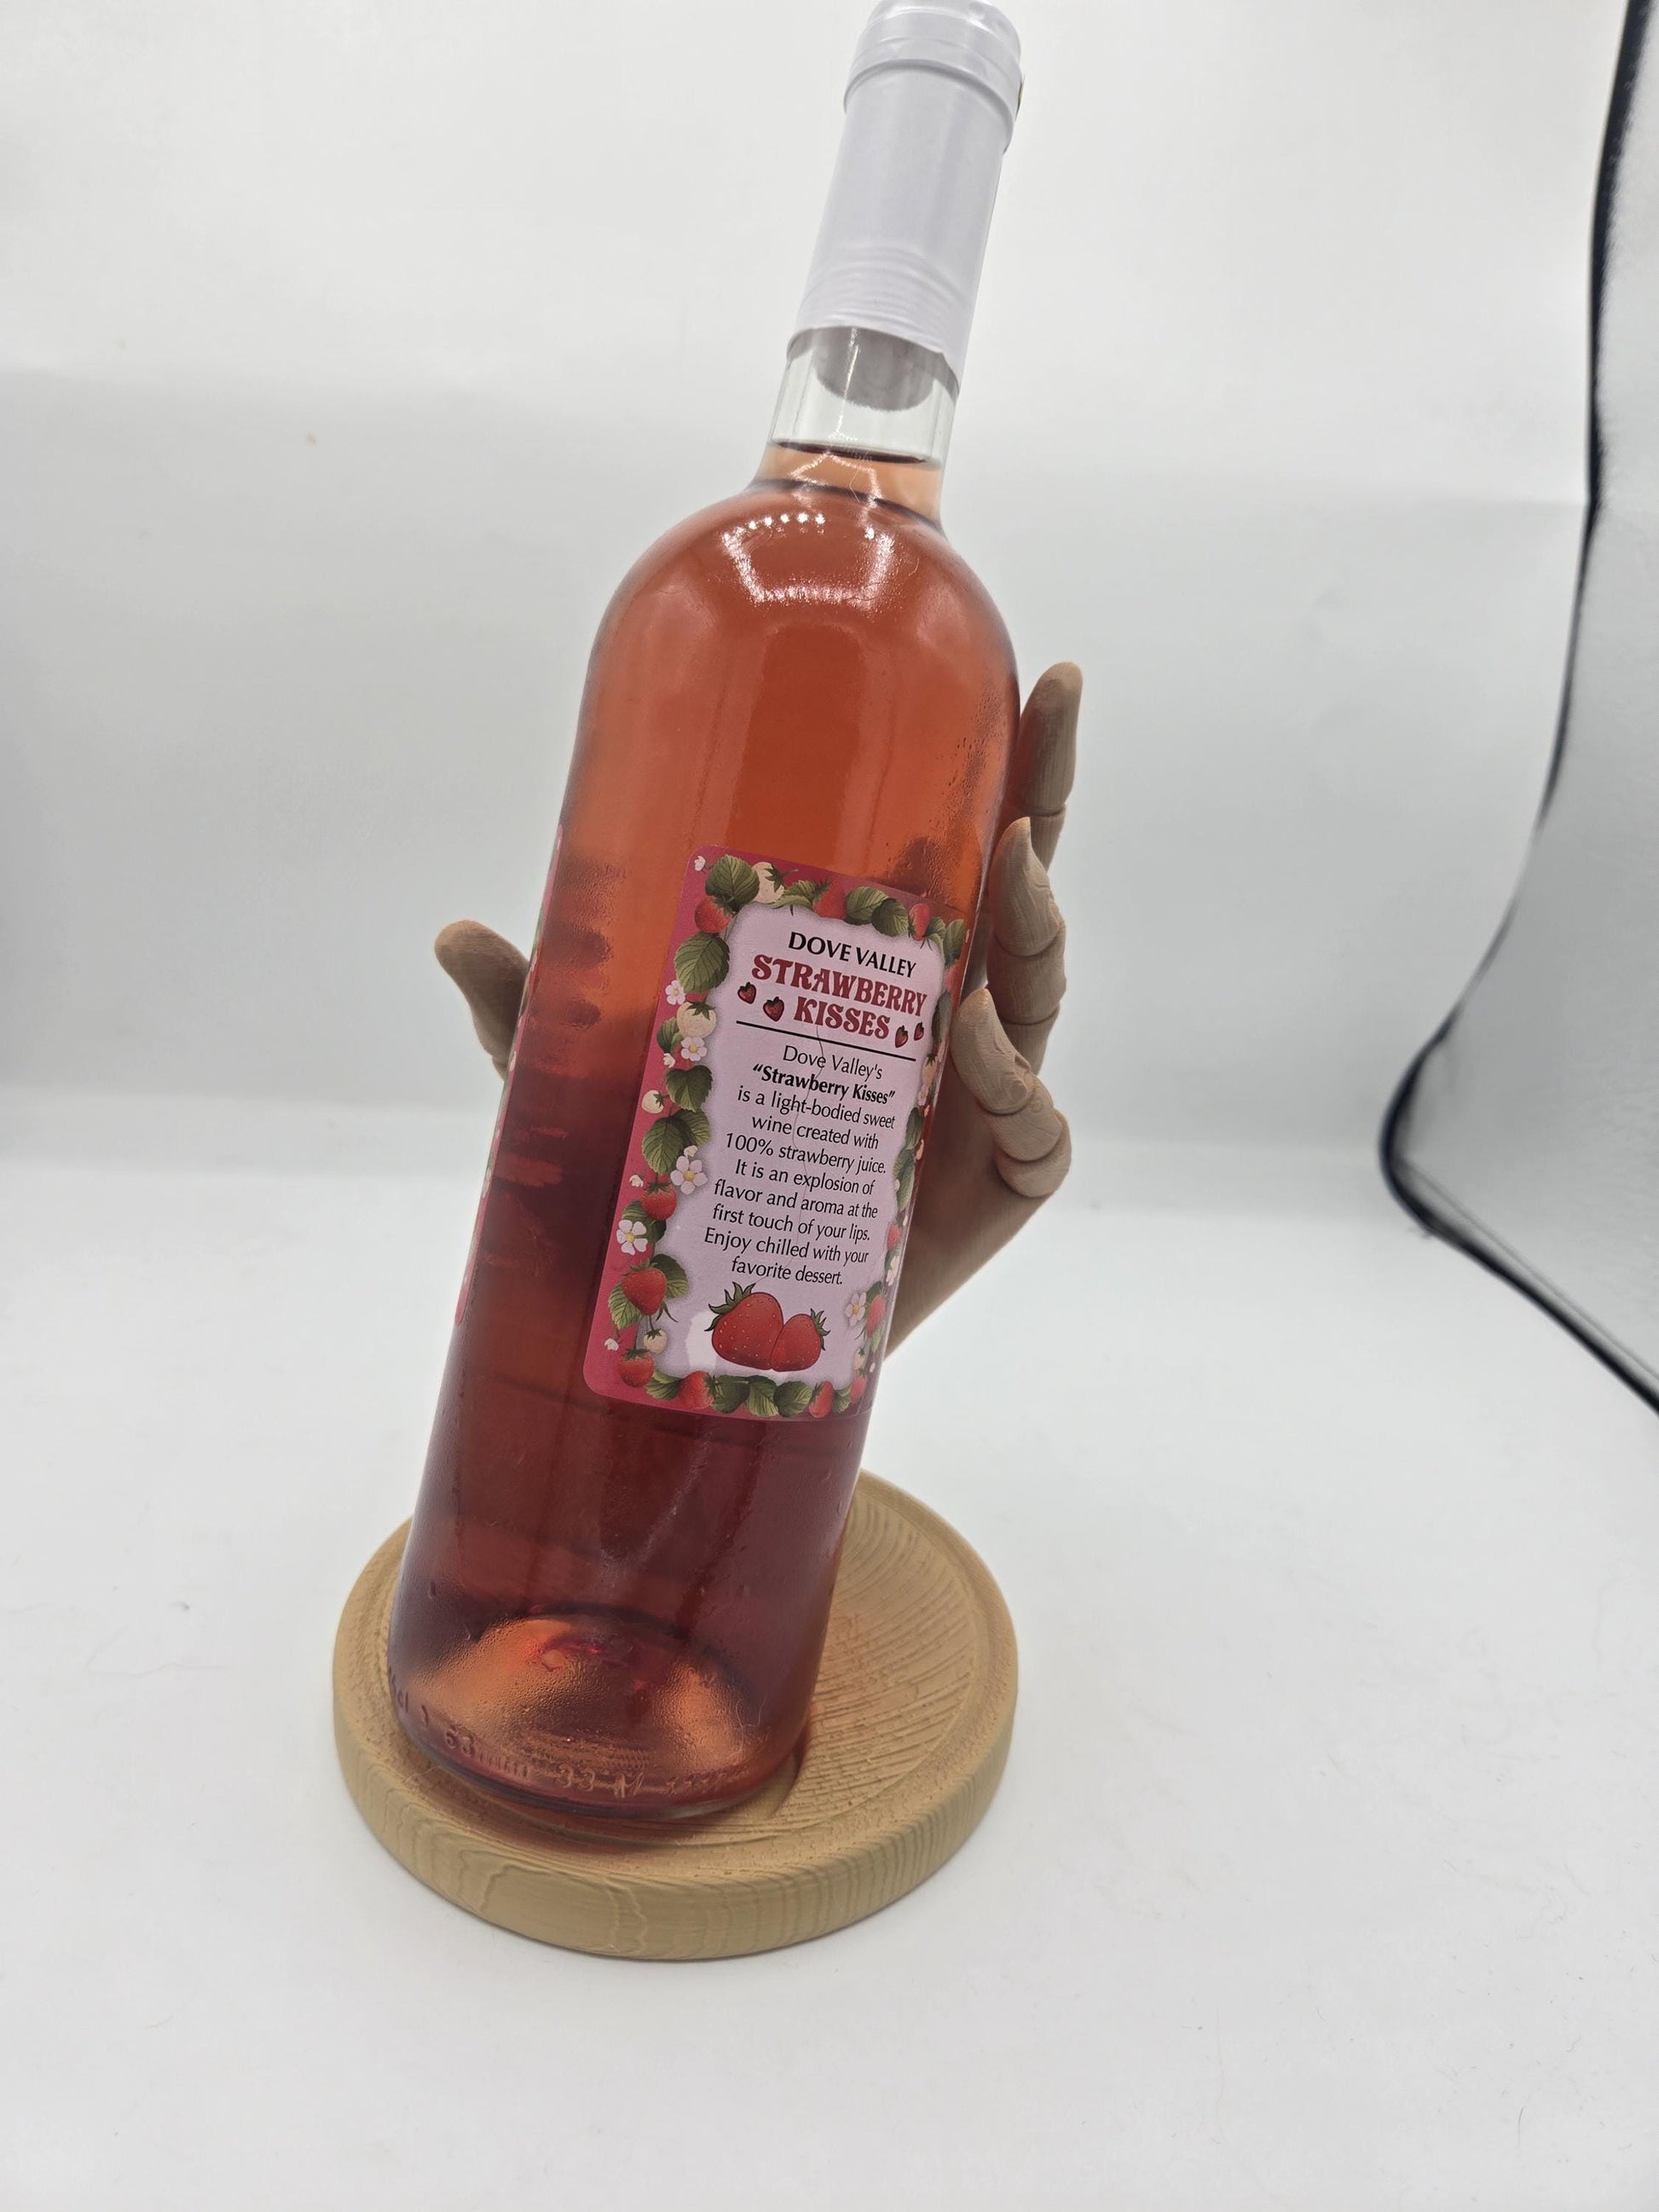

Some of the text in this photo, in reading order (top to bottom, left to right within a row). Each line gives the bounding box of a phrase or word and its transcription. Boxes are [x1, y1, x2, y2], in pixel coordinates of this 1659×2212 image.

[789, 932, 916, 978] DOVE VALLEY
[751, 954, 928, 1017] STRAWBERRY
[794, 996, 891, 1040] KISSES
[783, 1045, 882, 1082] Dove Valley's
[737, 1085, 895, 1129] is a light-bodied sweet
[752, 1115, 879, 1149] wine created with
[725, 1132, 886, 1175] 100% strawberry juice.
[735, 1158, 876, 1195] It is an explosion of
[714, 1179, 878, 1219] flavor and aroma at the
[713, 1204, 870, 1242] first touch of your lips.
[704, 1227, 869, 1267] Enjoy chilled with your
[731, 1256, 843, 1285] favorite dessert.
